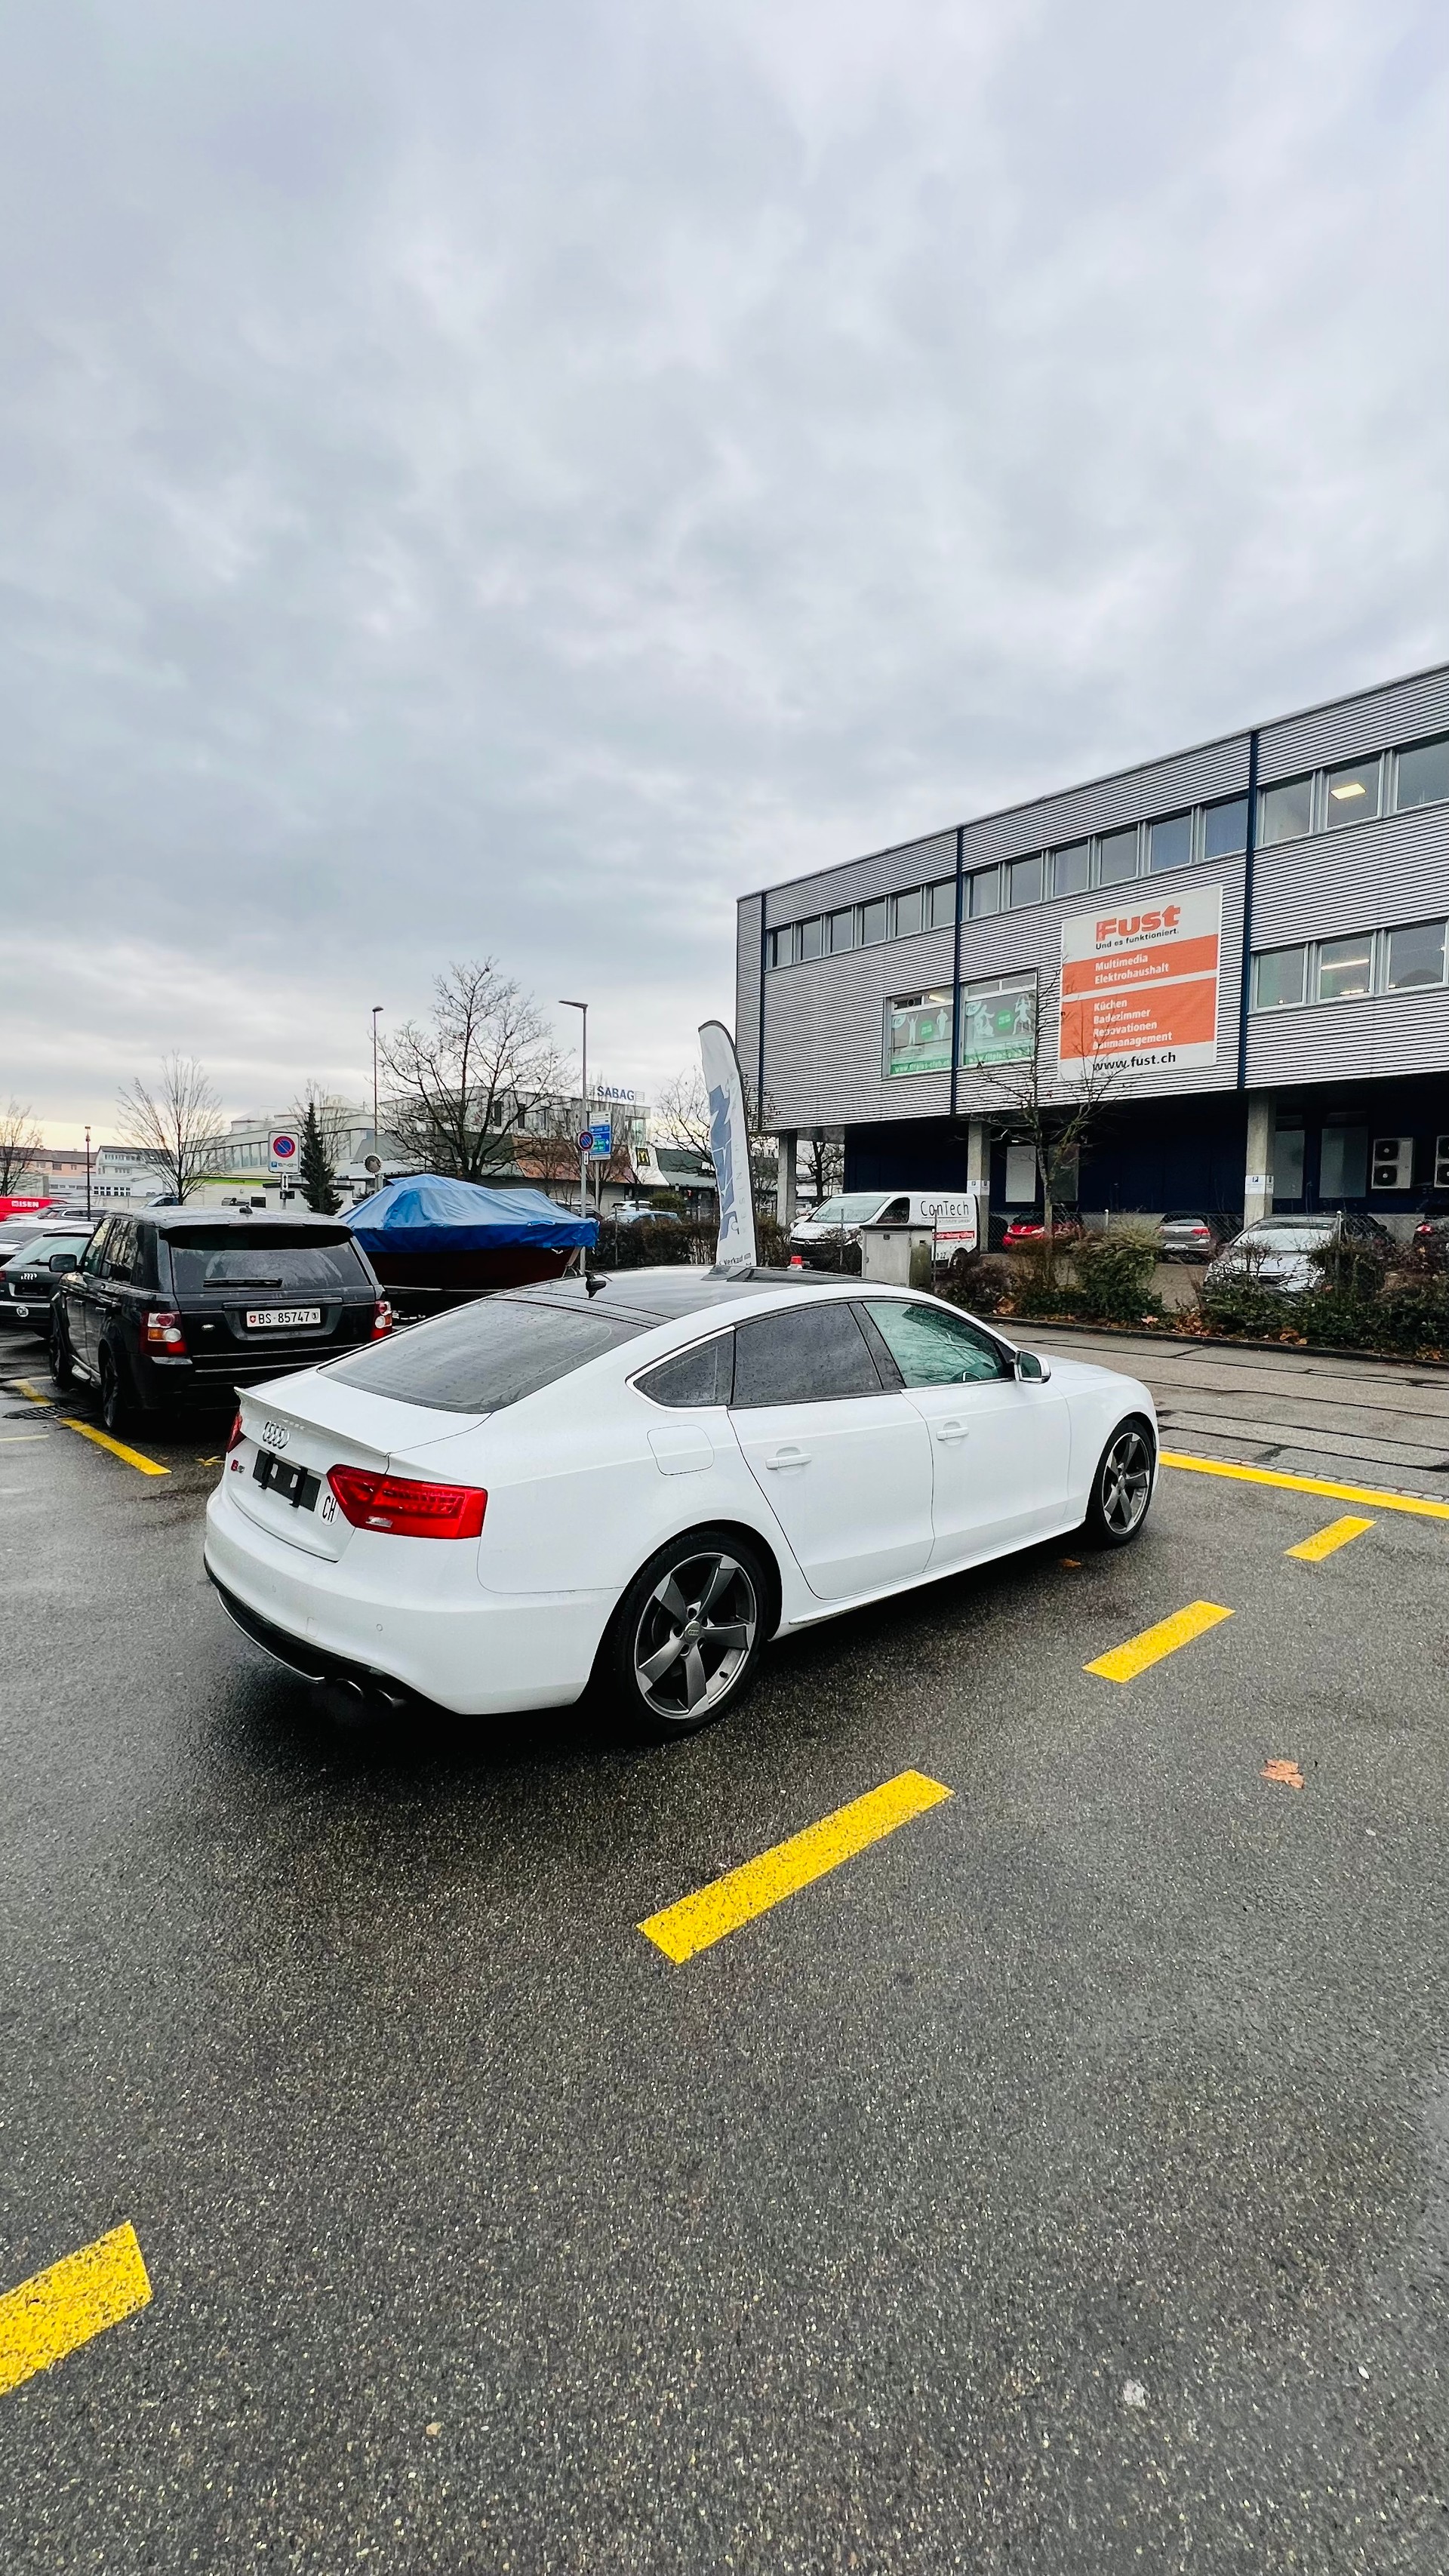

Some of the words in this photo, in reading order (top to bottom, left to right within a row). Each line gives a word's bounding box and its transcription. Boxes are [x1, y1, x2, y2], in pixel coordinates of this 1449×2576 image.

[1096, 905, 1180, 942] Fust
[1096, 940, 1112, 949] Und
[1095, 953, 1149, 971] Multimedia
[1094, 962, 1170, 985] Elektrohaushalt
[1094, 999, 1128, 1011] Küchen
[1094, 1009, 1151, 1024] Badezimmer
[1093, 1021, 1158, 1037] Renovationen
[1093, 1031, 1173, 1050] Baumanagement
[1093, 1051, 1176, 1071] www.fust.ch
[597, 1085, 635, 1100] SABAG
[921, 1201, 969, 1216] ConTech
[258, 1313, 272, 1325] BS
[278, 1311, 309, 1323] 85747
[322, 1495, 337, 1523] CH
